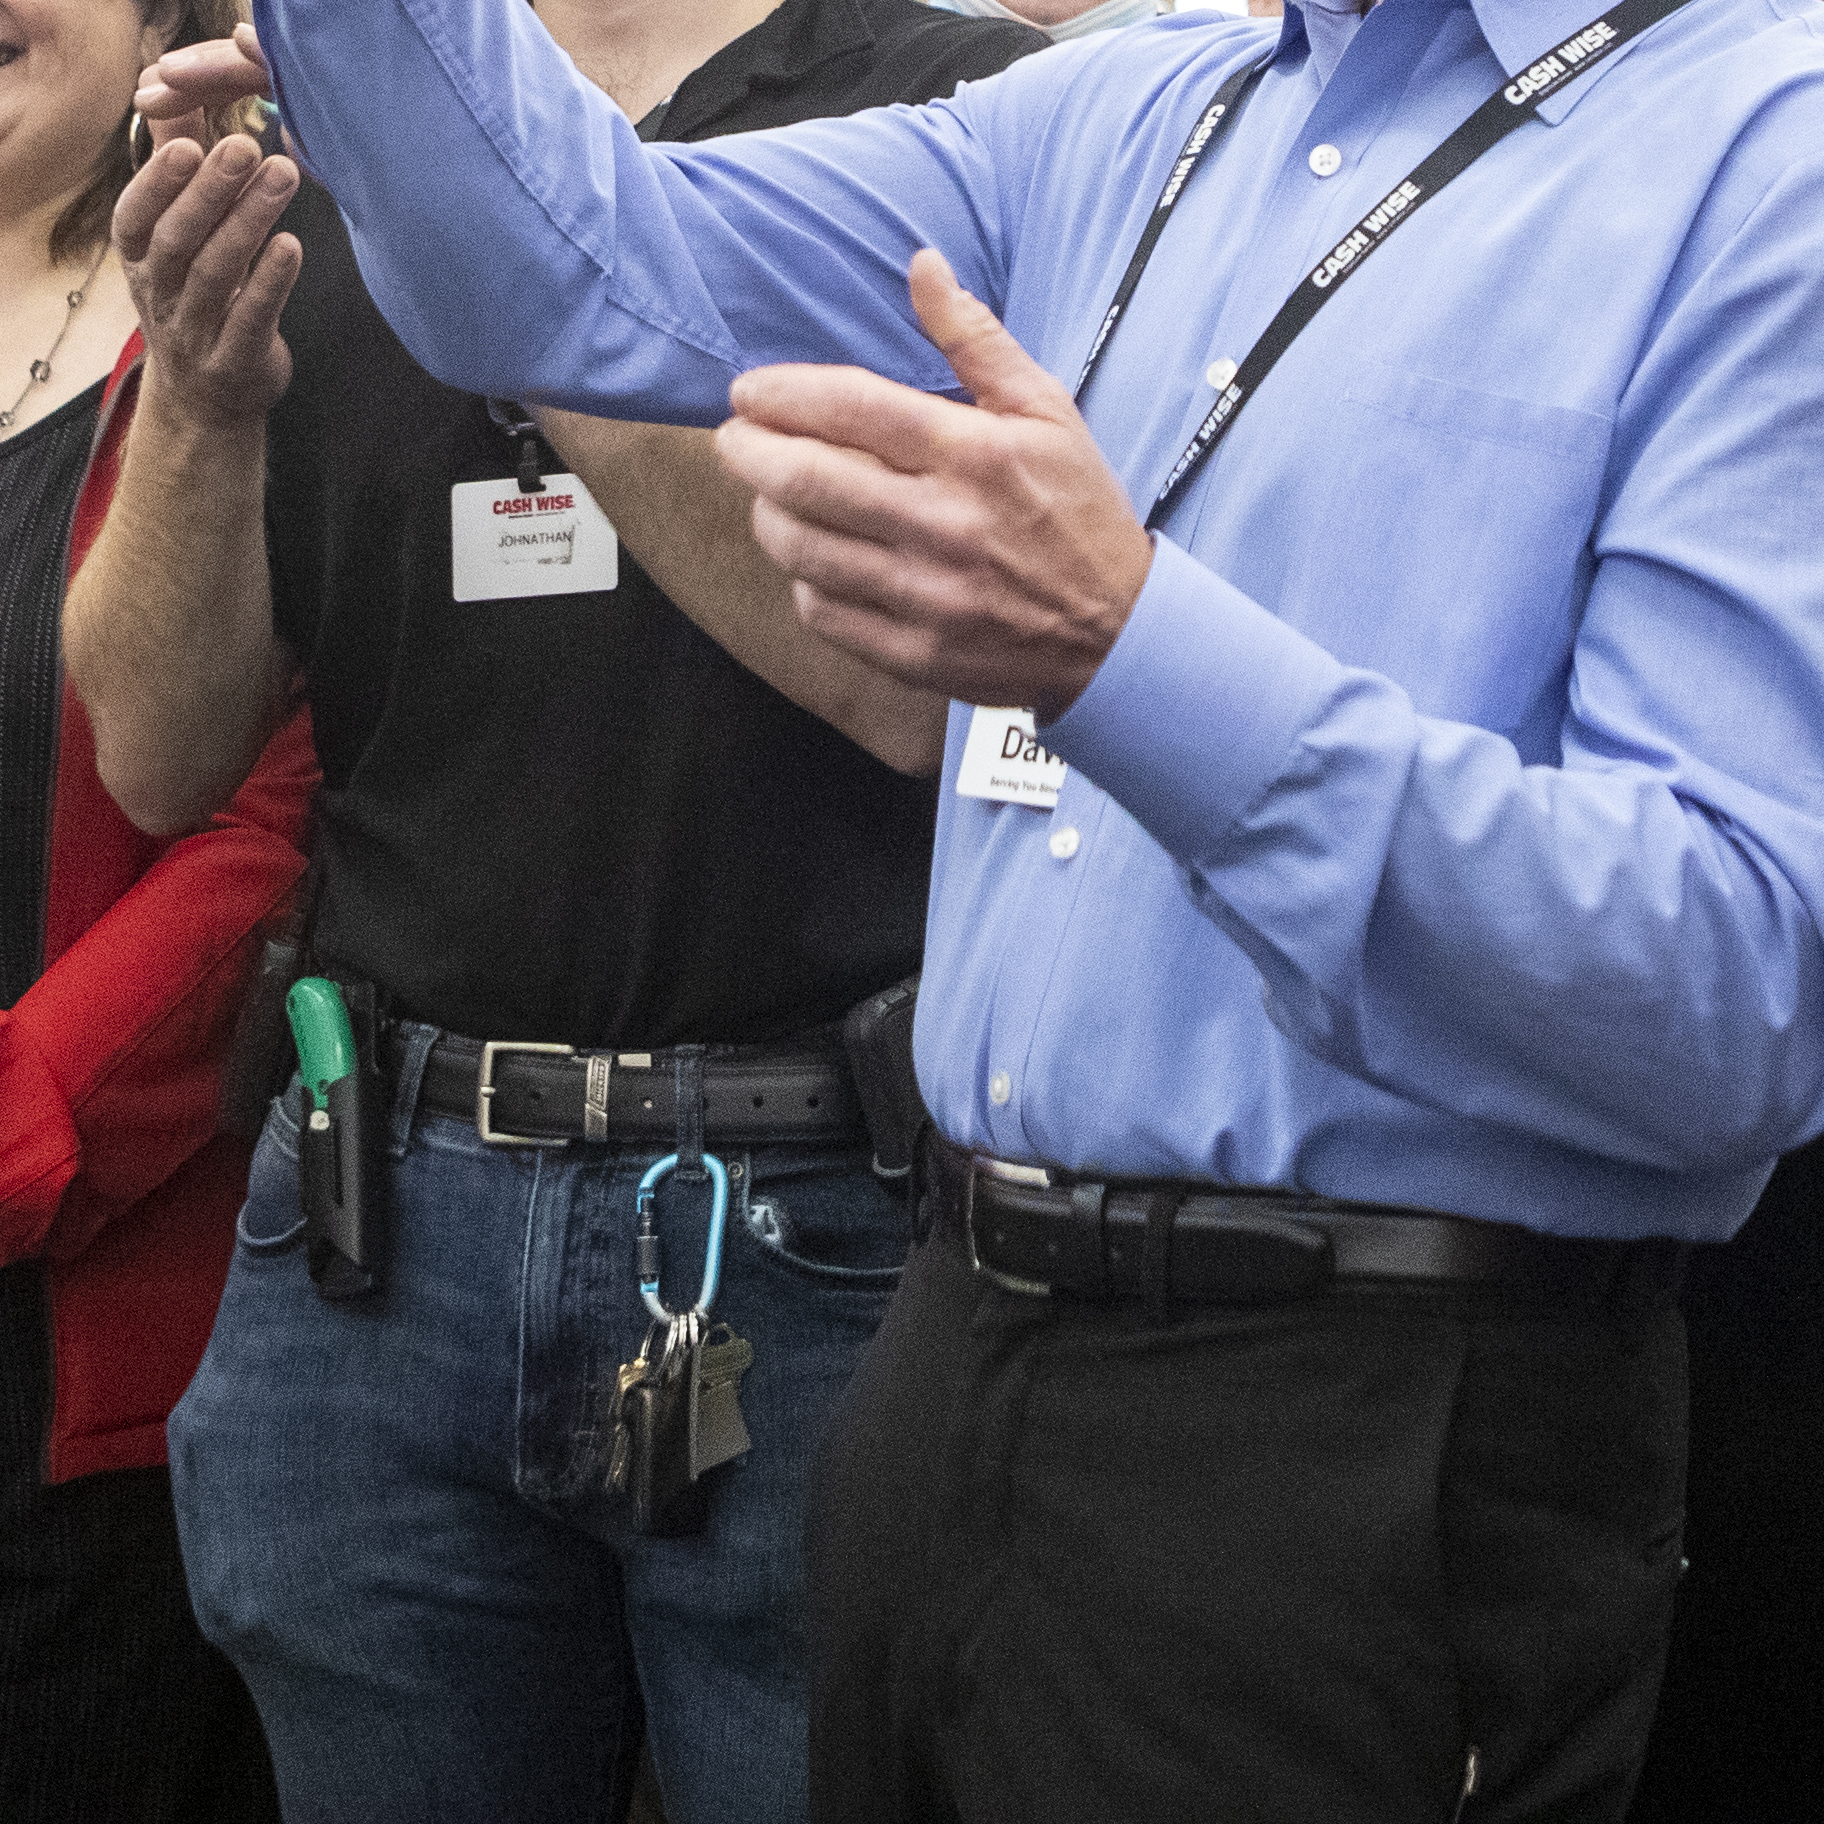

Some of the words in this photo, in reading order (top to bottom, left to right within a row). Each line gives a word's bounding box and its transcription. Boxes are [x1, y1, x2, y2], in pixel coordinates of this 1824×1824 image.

[1504, 56, 1567, 105] CASH
[1557, 21, 1617, 64] WISE
[1186, 104, 1226, 155] CASH
[1159, 156, 1196, 208] WISE
[1312, 229, 1369, 288] CASH
[1362, 180, 1421, 233] WISE
[1159, 441, 1200, 500] CASH
[1199, 383, 1242, 440] WISE
[493, 497, 532, 515] CASH
[536, 495, 575, 511] WISE
[498, 531, 572, 548] JOHNATHAN
[1000, 724, 1065, 765] Dav
